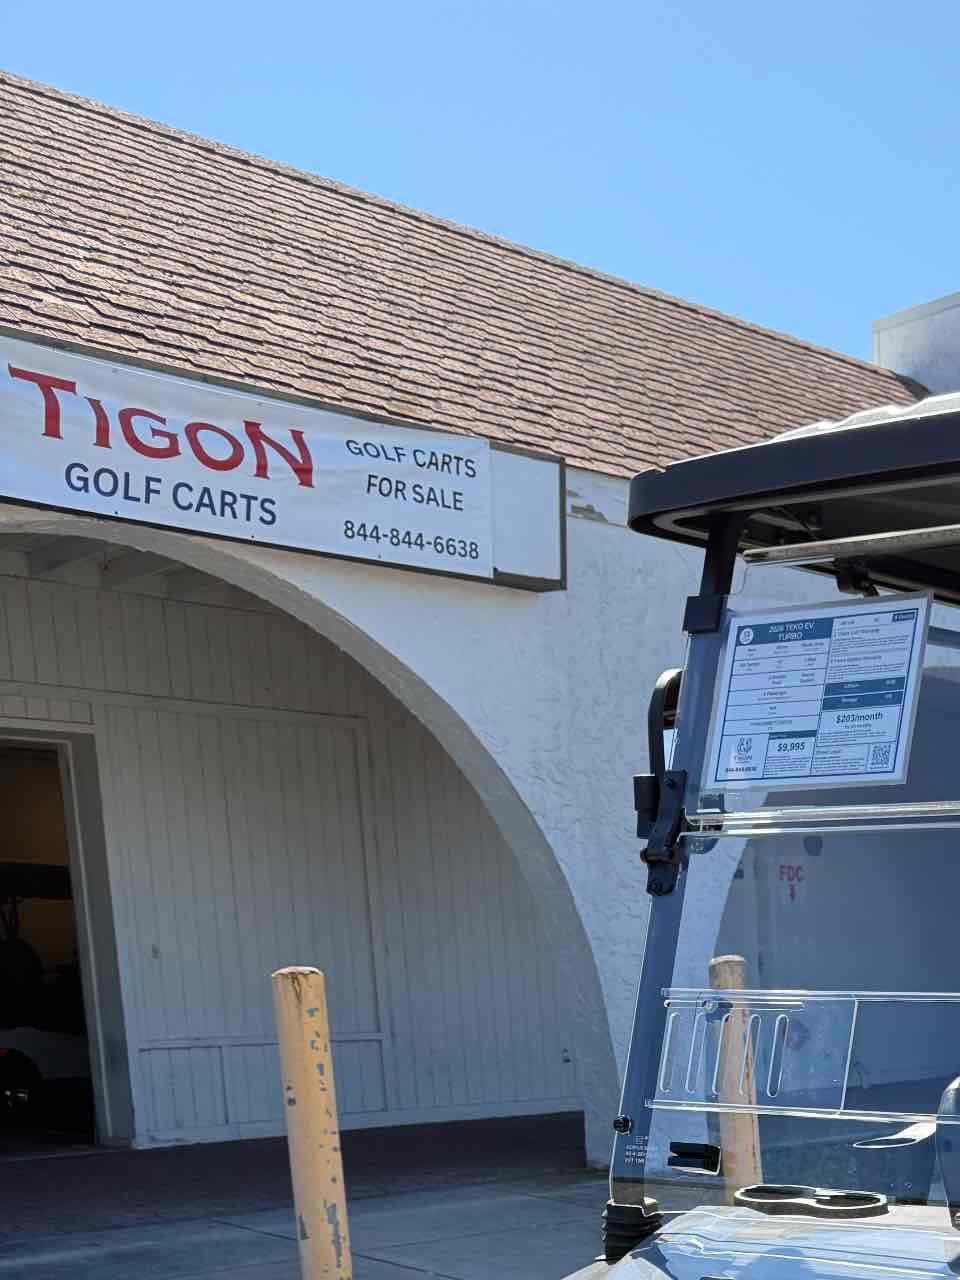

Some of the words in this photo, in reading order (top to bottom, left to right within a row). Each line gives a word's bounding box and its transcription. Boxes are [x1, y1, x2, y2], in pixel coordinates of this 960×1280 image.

[8, 363, 314, 488] TIGON
[345, 439, 406, 463] GOLF
[413, 449, 477, 478] CARTS
[64, 462, 162, 504] GOLF
[172, 482, 277, 525] CARTS
[366, 474, 407, 501] FOR
[412, 484, 464, 511] SALE
[344, 520, 479, 560] 844-844-6638
[779, 864, 804, 882] FDC
